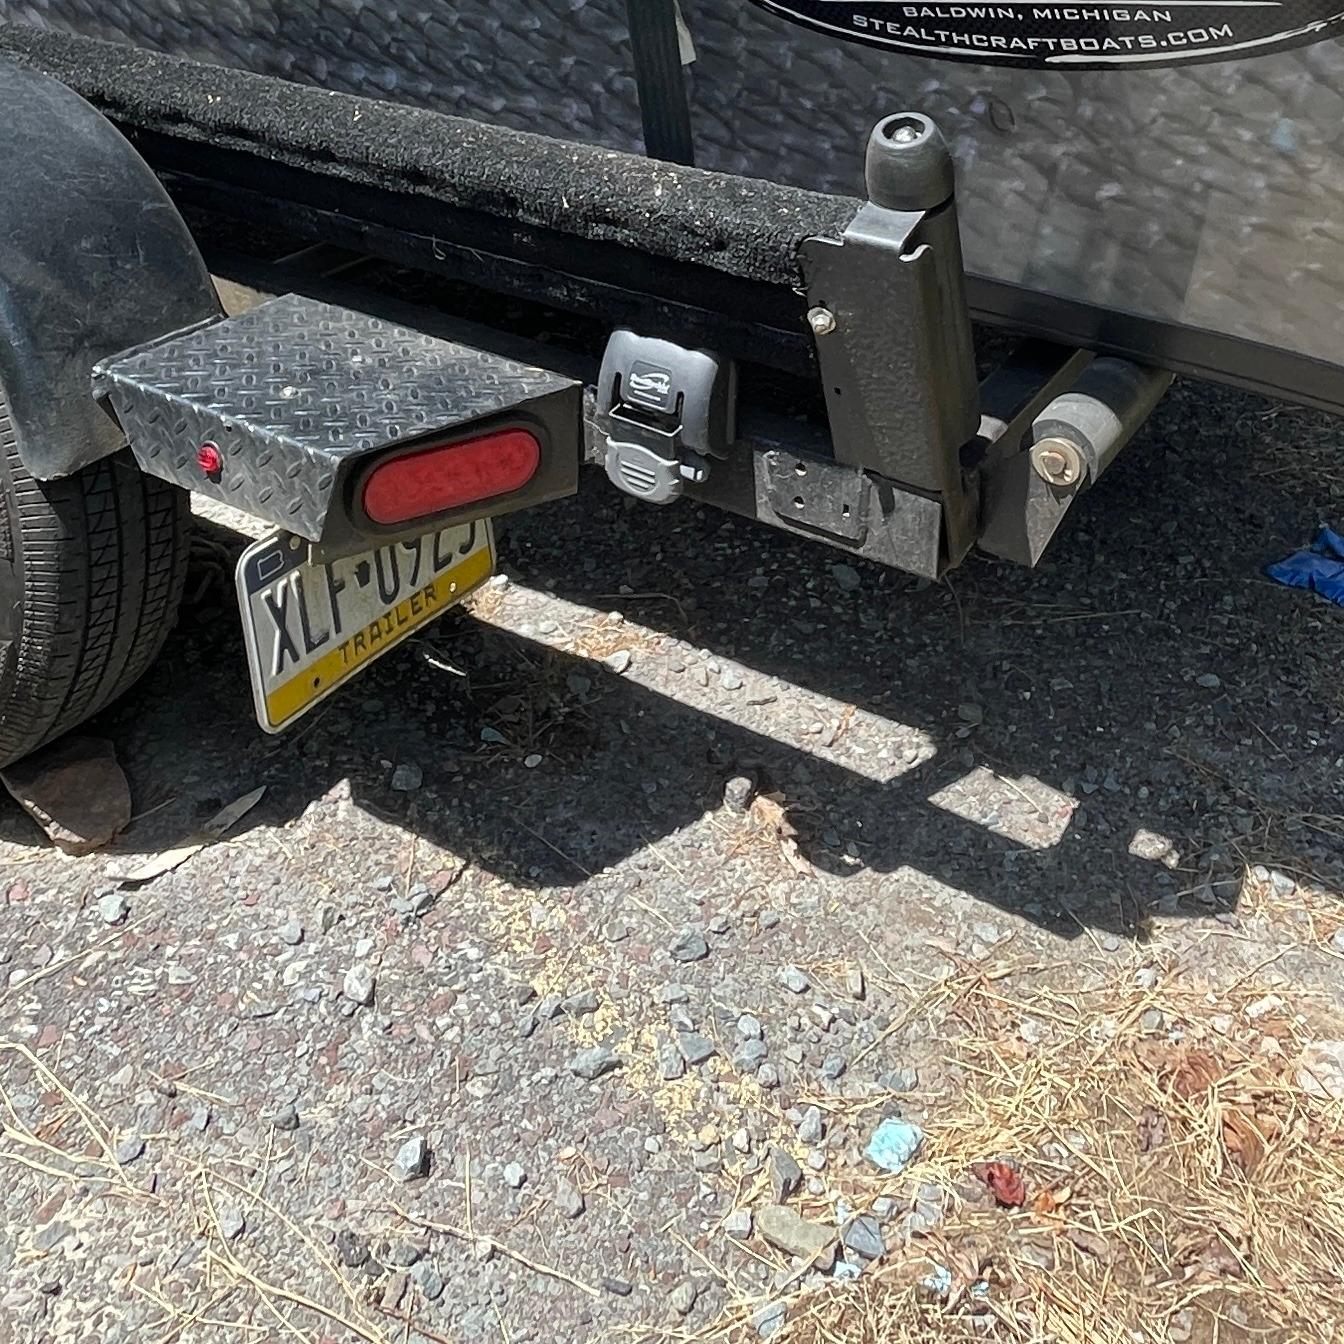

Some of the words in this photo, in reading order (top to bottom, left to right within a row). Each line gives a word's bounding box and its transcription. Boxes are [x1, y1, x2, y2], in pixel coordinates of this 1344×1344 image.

[852, 14, 1234, 52] STEALTHCRAFTBOATS.COM
[902, 6, 1024, 21] BALDWIN,
[1032, 8, 1172, 23] MICHIGAN
[337, 582, 438, 664] TRAILER
